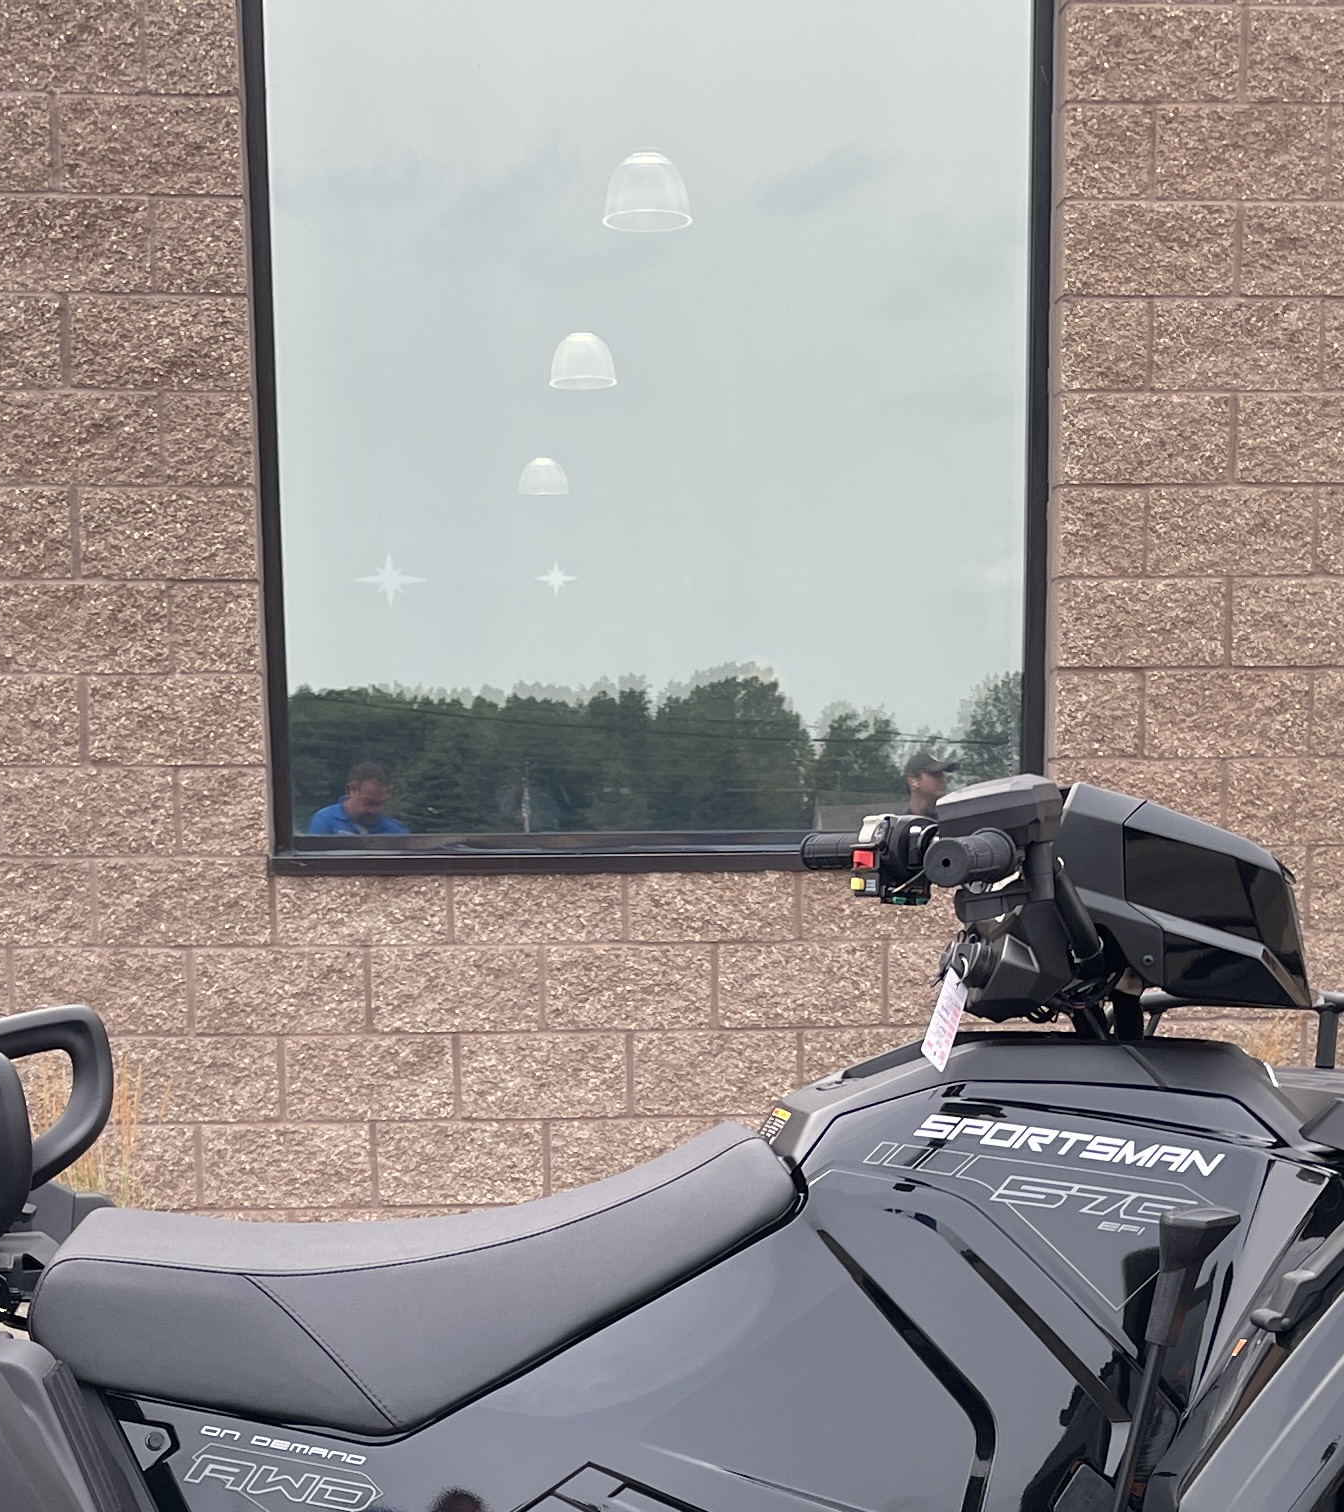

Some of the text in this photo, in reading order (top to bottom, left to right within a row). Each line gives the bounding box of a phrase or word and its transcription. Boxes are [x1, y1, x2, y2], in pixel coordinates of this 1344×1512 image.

[913, 1113, 1226, 1177] SPORTSMAN
[1096, 1220, 1146, 1236] EFI
[250, 1435, 367, 1466] DEMAND
[183, 1453, 377, 1512] AWD
